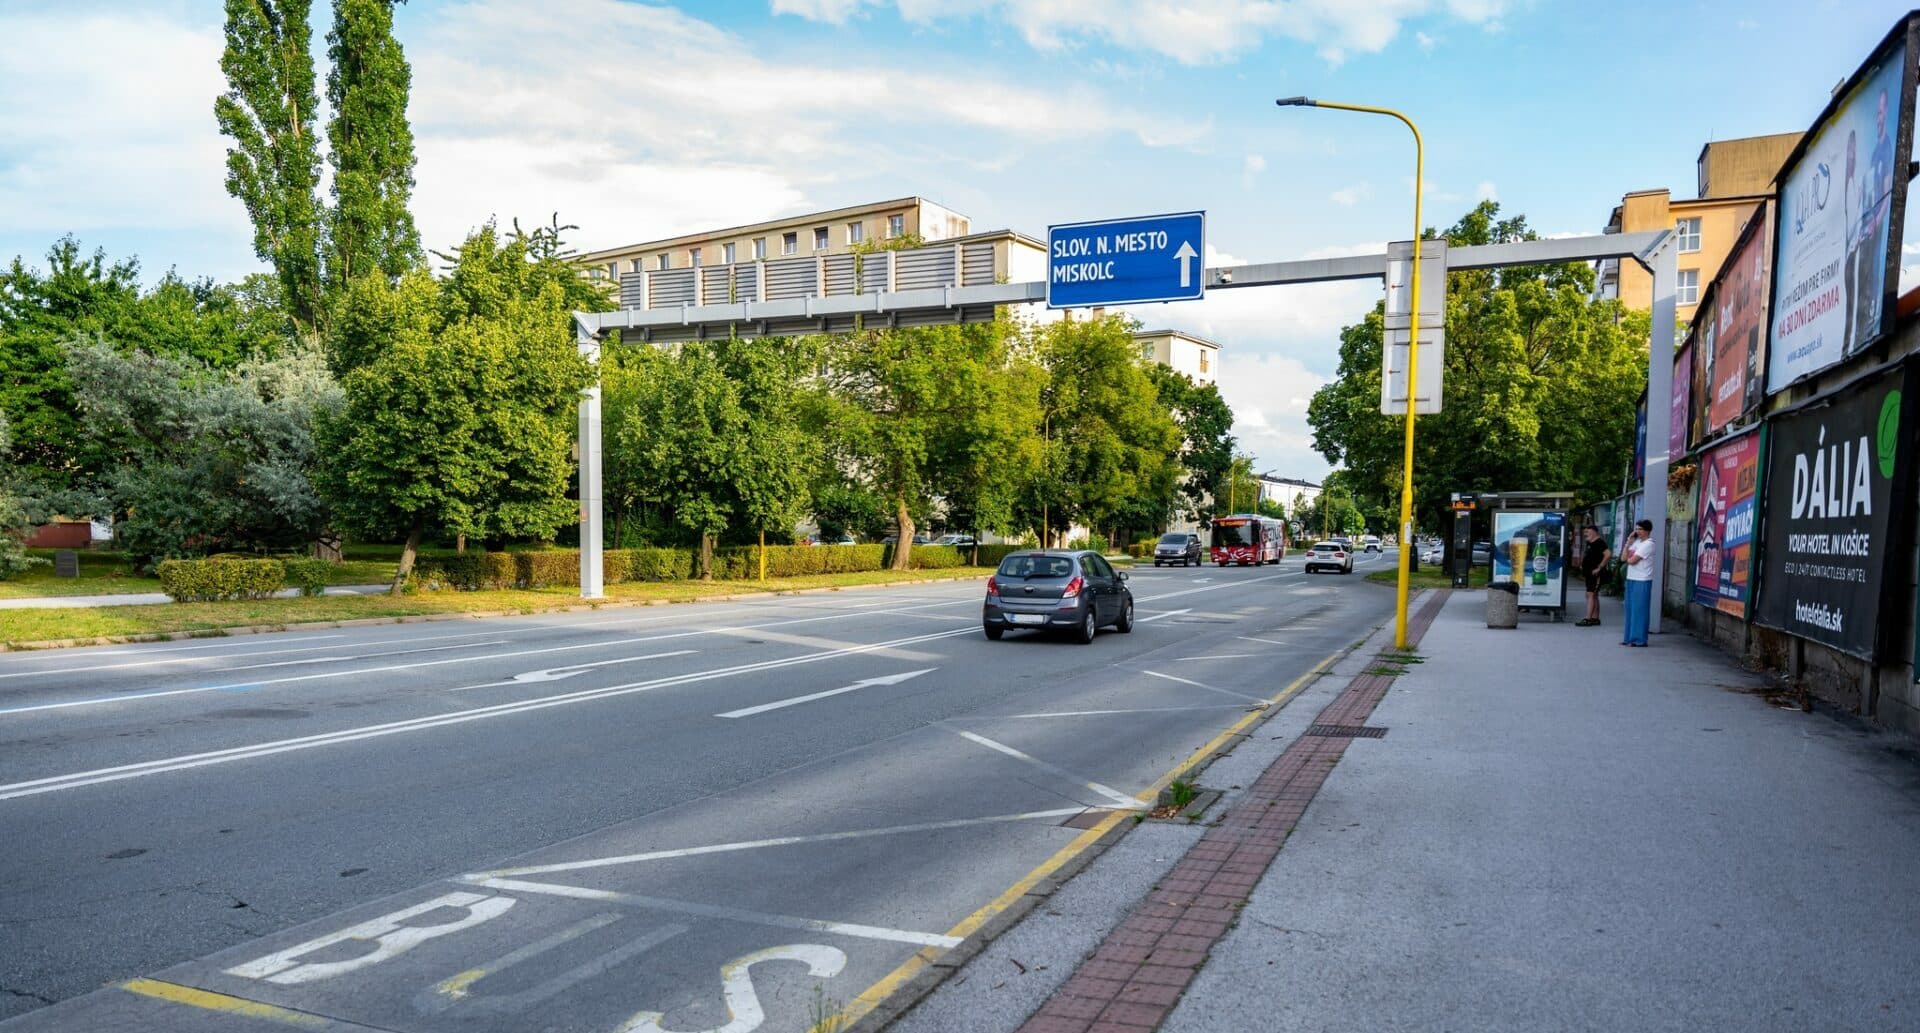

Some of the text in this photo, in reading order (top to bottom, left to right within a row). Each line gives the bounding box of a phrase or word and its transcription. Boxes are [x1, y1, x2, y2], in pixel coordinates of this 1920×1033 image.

[1053, 230, 1168, 258] SLOV. N. MESTO
[1053, 260, 1115, 283] MISKOLC
[1809, 272, 1819, 292] PRE
[1820, 257, 1840, 285] FIRMY
[1786, 314, 1793, 335] 30
[1794, 299, 1806, 330] DNÍ
[1807, 284, 1840, 323] ZDARMA
[1791, 423, 1872, 519] DÁLIA
[1789, 528, 1869, 556] YOUR HOTEL IN KOŠICE
[1784, 562, 1795, 574] ECO
[1810, 565, 1846, 580] CONTACTLESS
[1846, 568, 1866, 583] HOTEL
[1796, 599, 1843, 632] hoteldalia.sk
